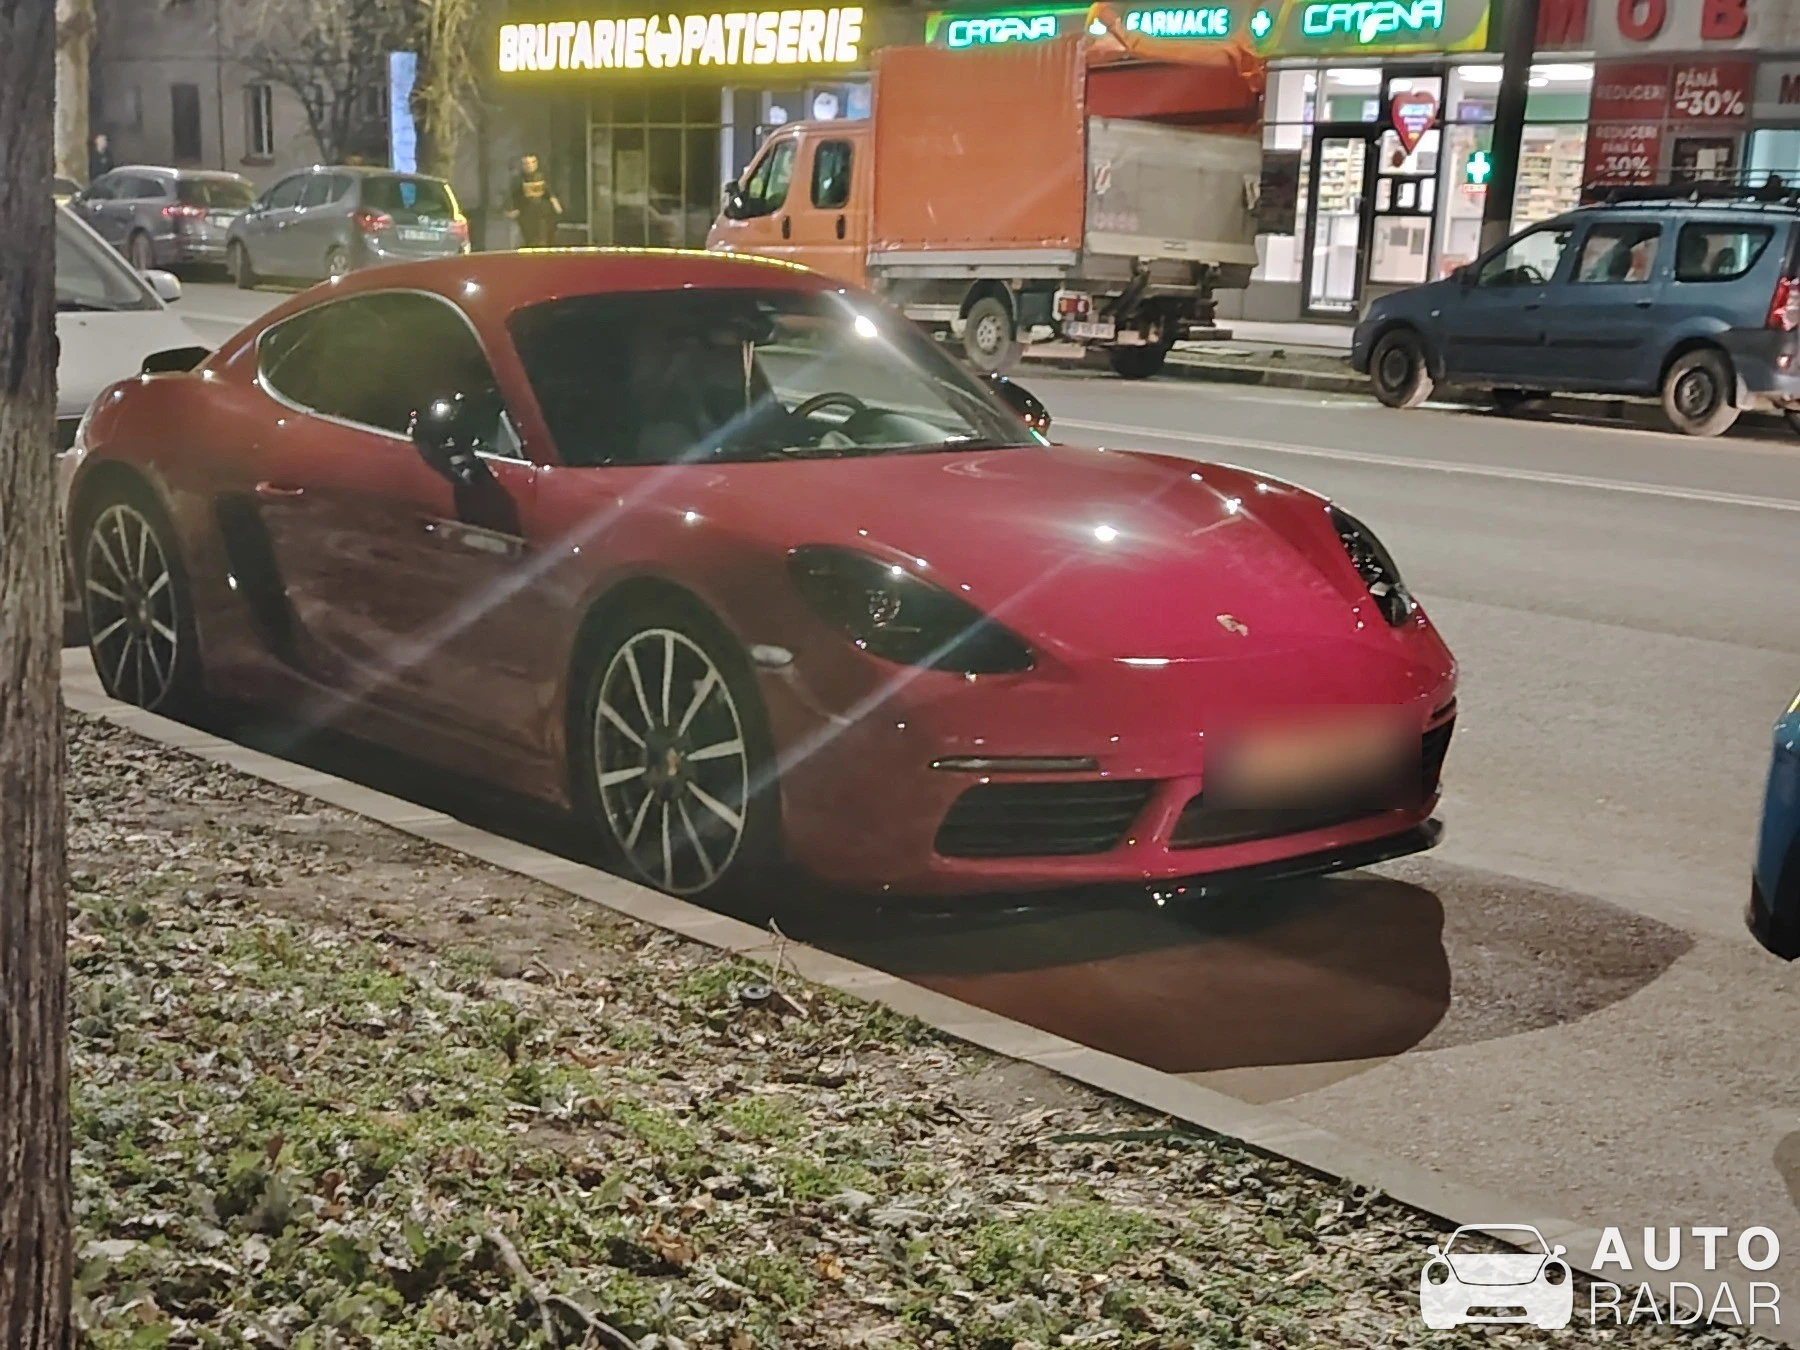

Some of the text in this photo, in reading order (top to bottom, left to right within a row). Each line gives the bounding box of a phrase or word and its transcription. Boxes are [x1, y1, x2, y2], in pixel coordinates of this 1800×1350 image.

[948, 16, 1056, 47] CATENA
[1126, 8, 1229, 37] FARMACIE
[1303, 0, 1444, 43] CATENA
[499, 7, 864, 72] BRUTARIE PATISERIE
[1596, 85, 1667, 100] REDUCERI
[1676, 89, 1744, 116] -30%
[1596, 126, 1657, 139] REDUCERI
[1596, 156, 1651, 177] -30%
